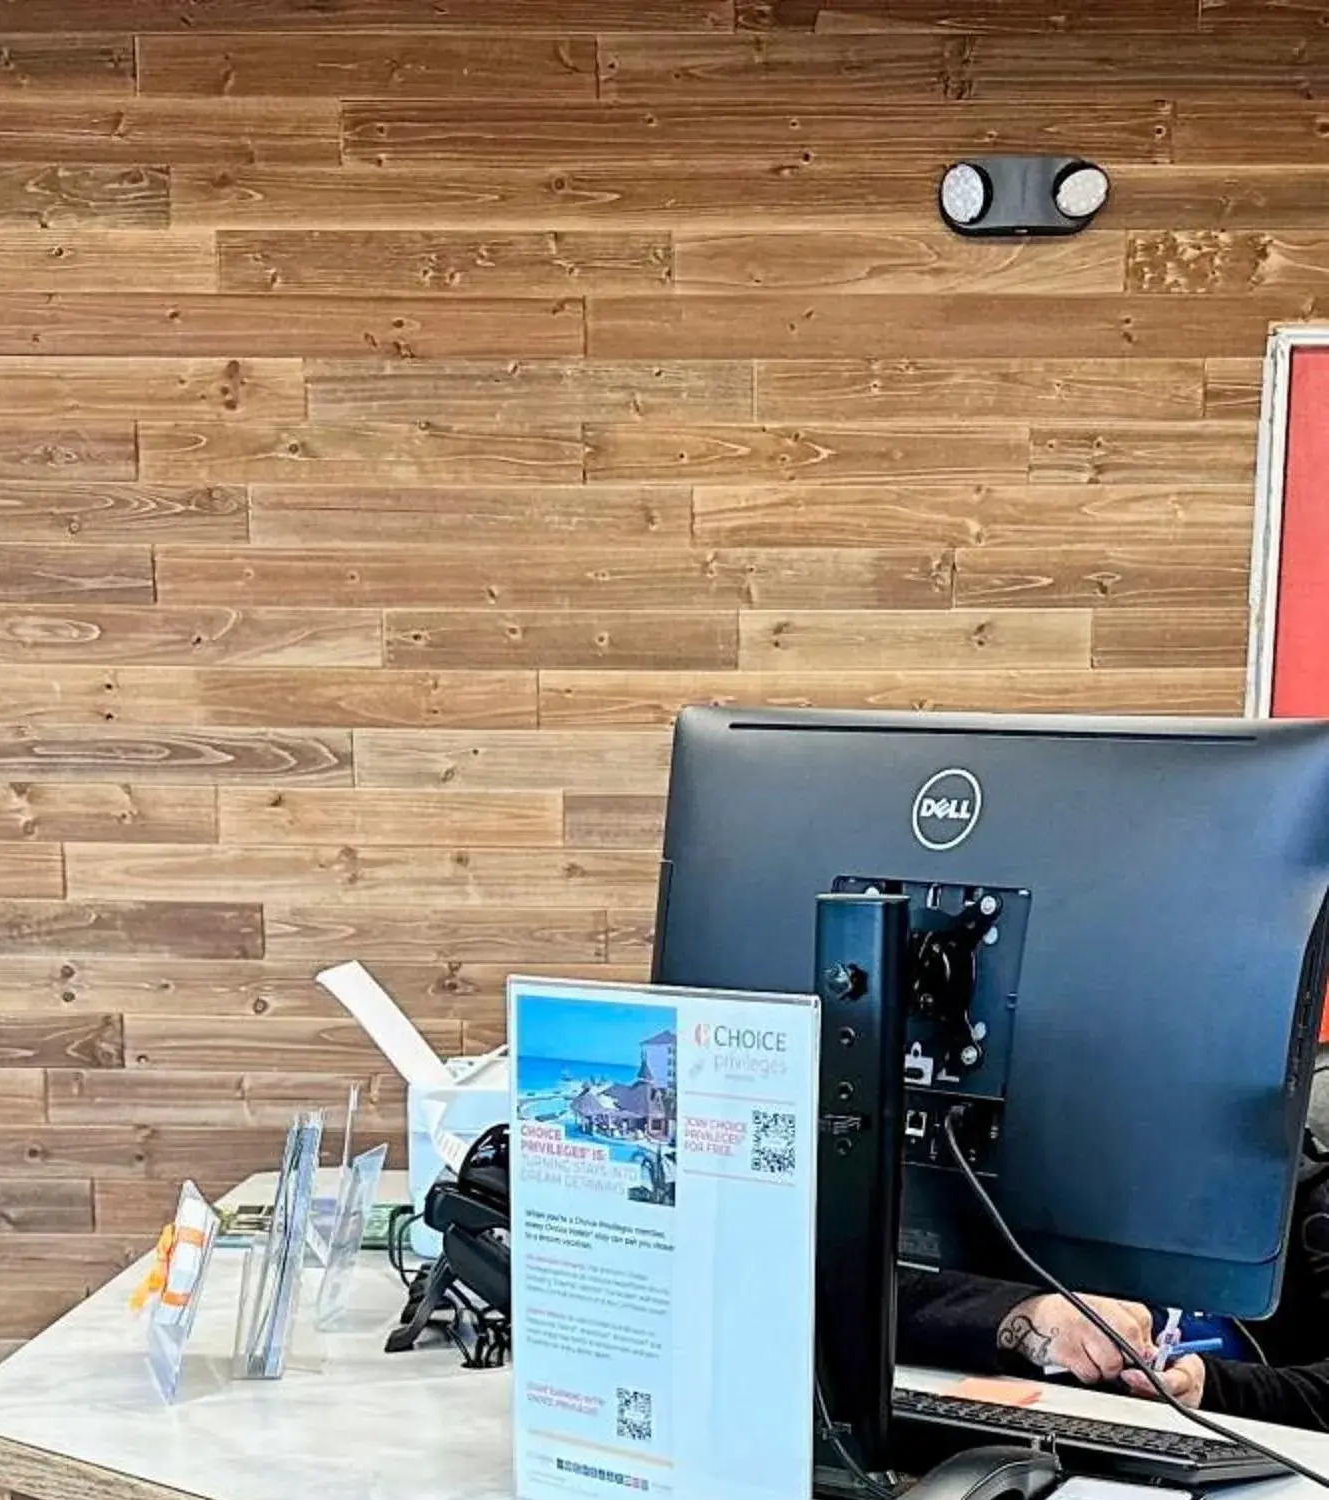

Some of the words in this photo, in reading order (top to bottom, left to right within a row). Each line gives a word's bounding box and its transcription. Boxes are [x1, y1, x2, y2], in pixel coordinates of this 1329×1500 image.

[920, 797, 971, 820] DELL
[714, 1025, 788, 1053] CHOICE
[714, 1055, 788, 1080] privileges
[521, 1124, 562, 1140] CHOICE
